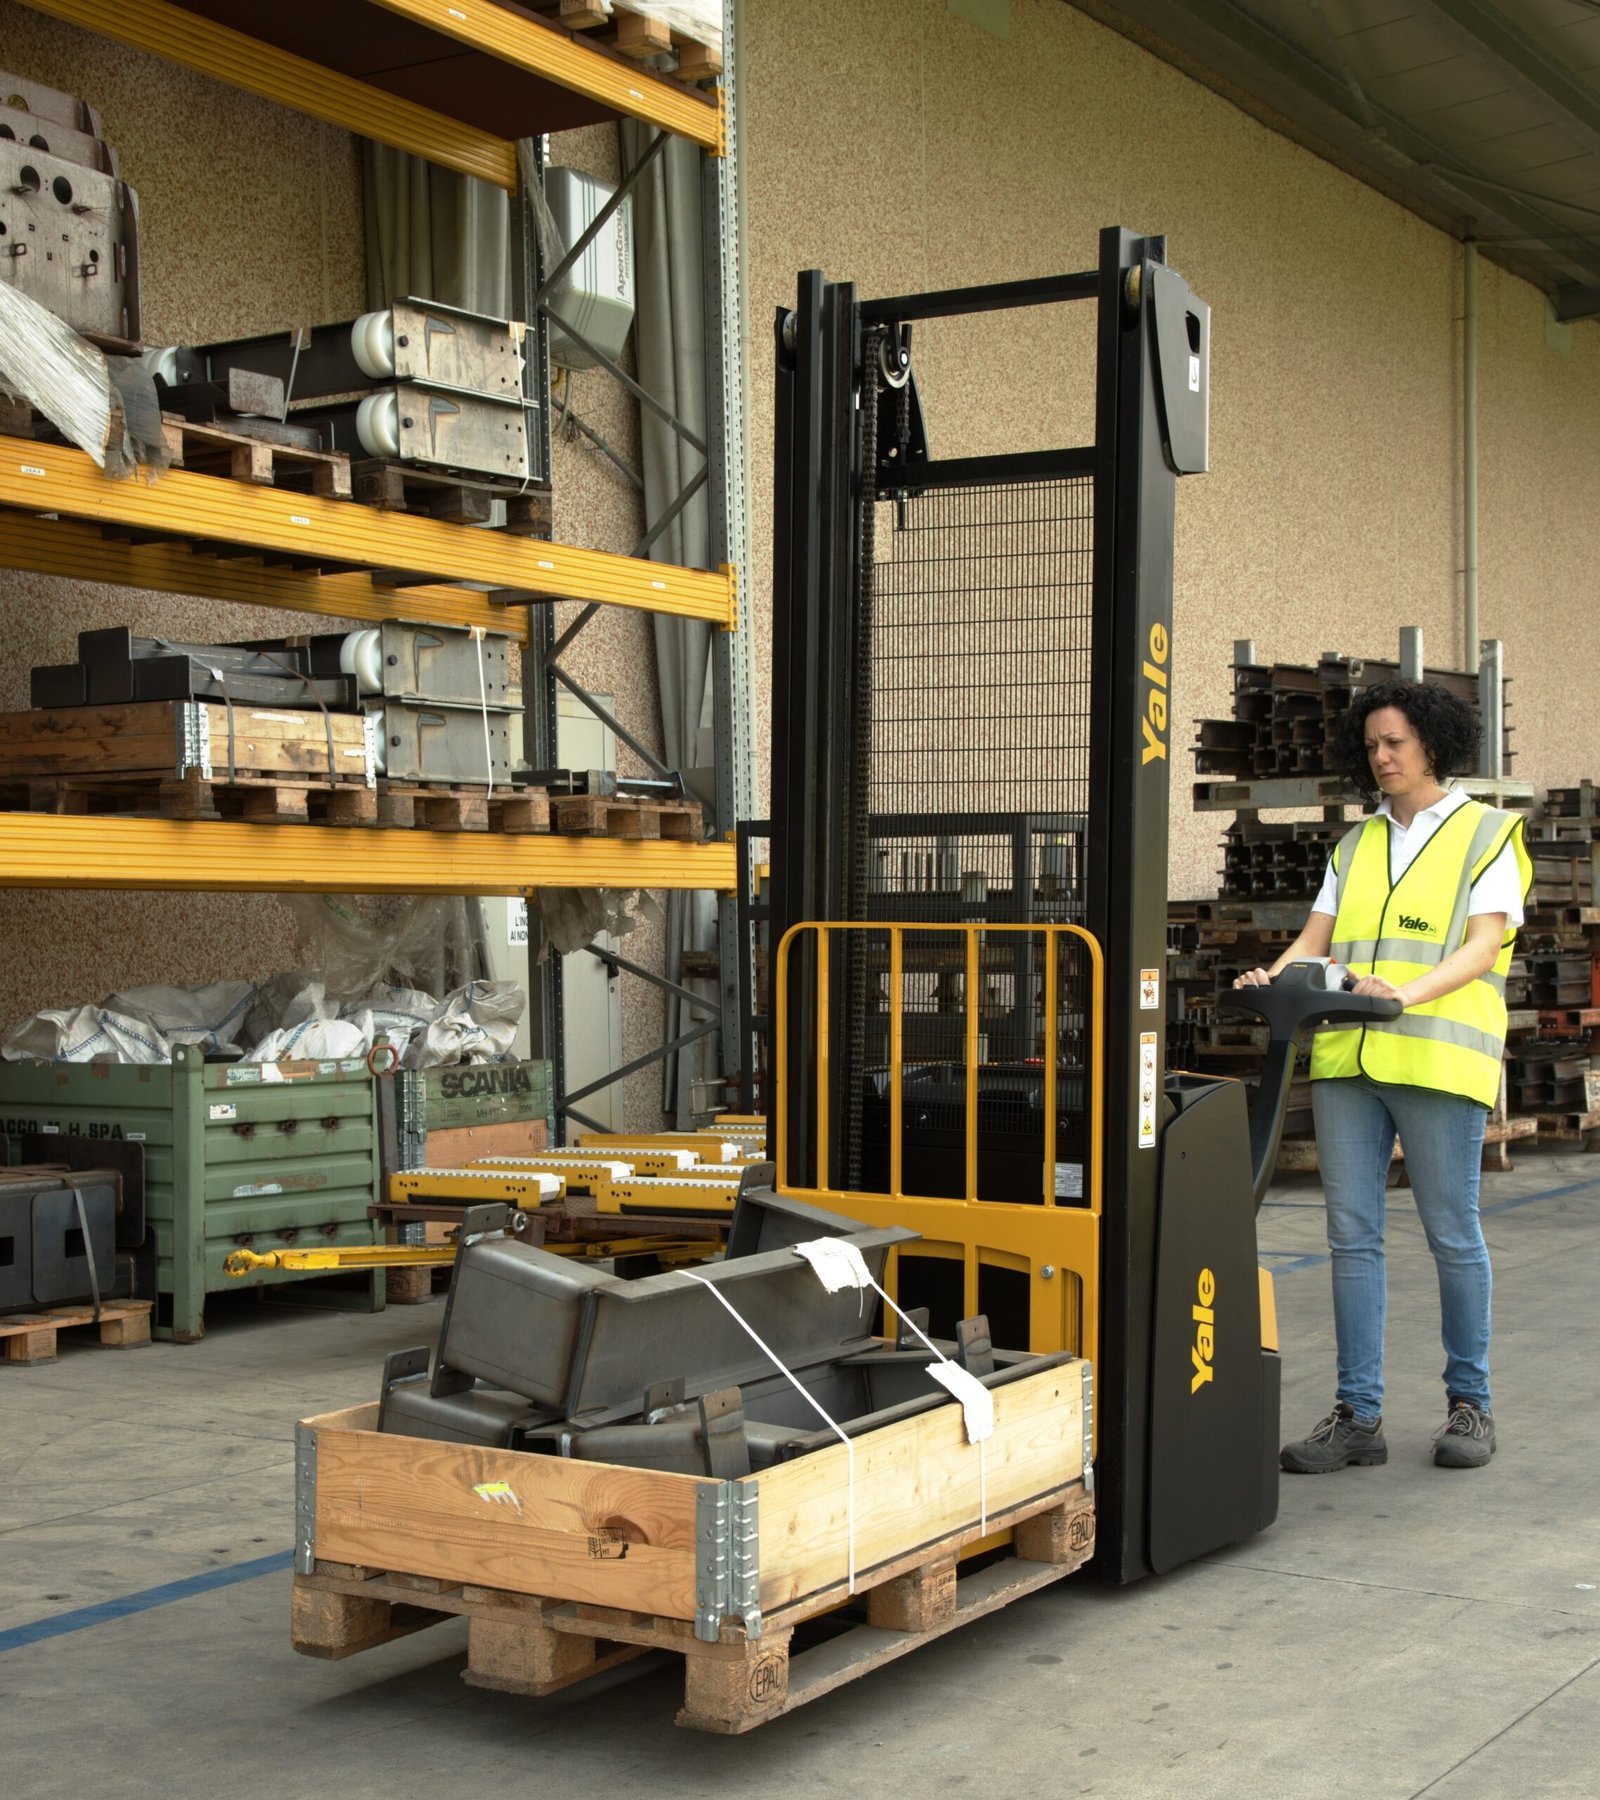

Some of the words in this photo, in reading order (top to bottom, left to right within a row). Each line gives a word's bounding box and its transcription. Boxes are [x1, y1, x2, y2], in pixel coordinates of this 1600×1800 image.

[1142, 622, 1168, 766] Yale
[1398, 914, 1429, 931] Yale
[441, 1067, 532, 1099] SCANIA
[1191, 1267, 1215, 1395] Yale
[1071, 1516, 1090, 1547] EPAL
[755, 1661, 781, 1698] EPAL
